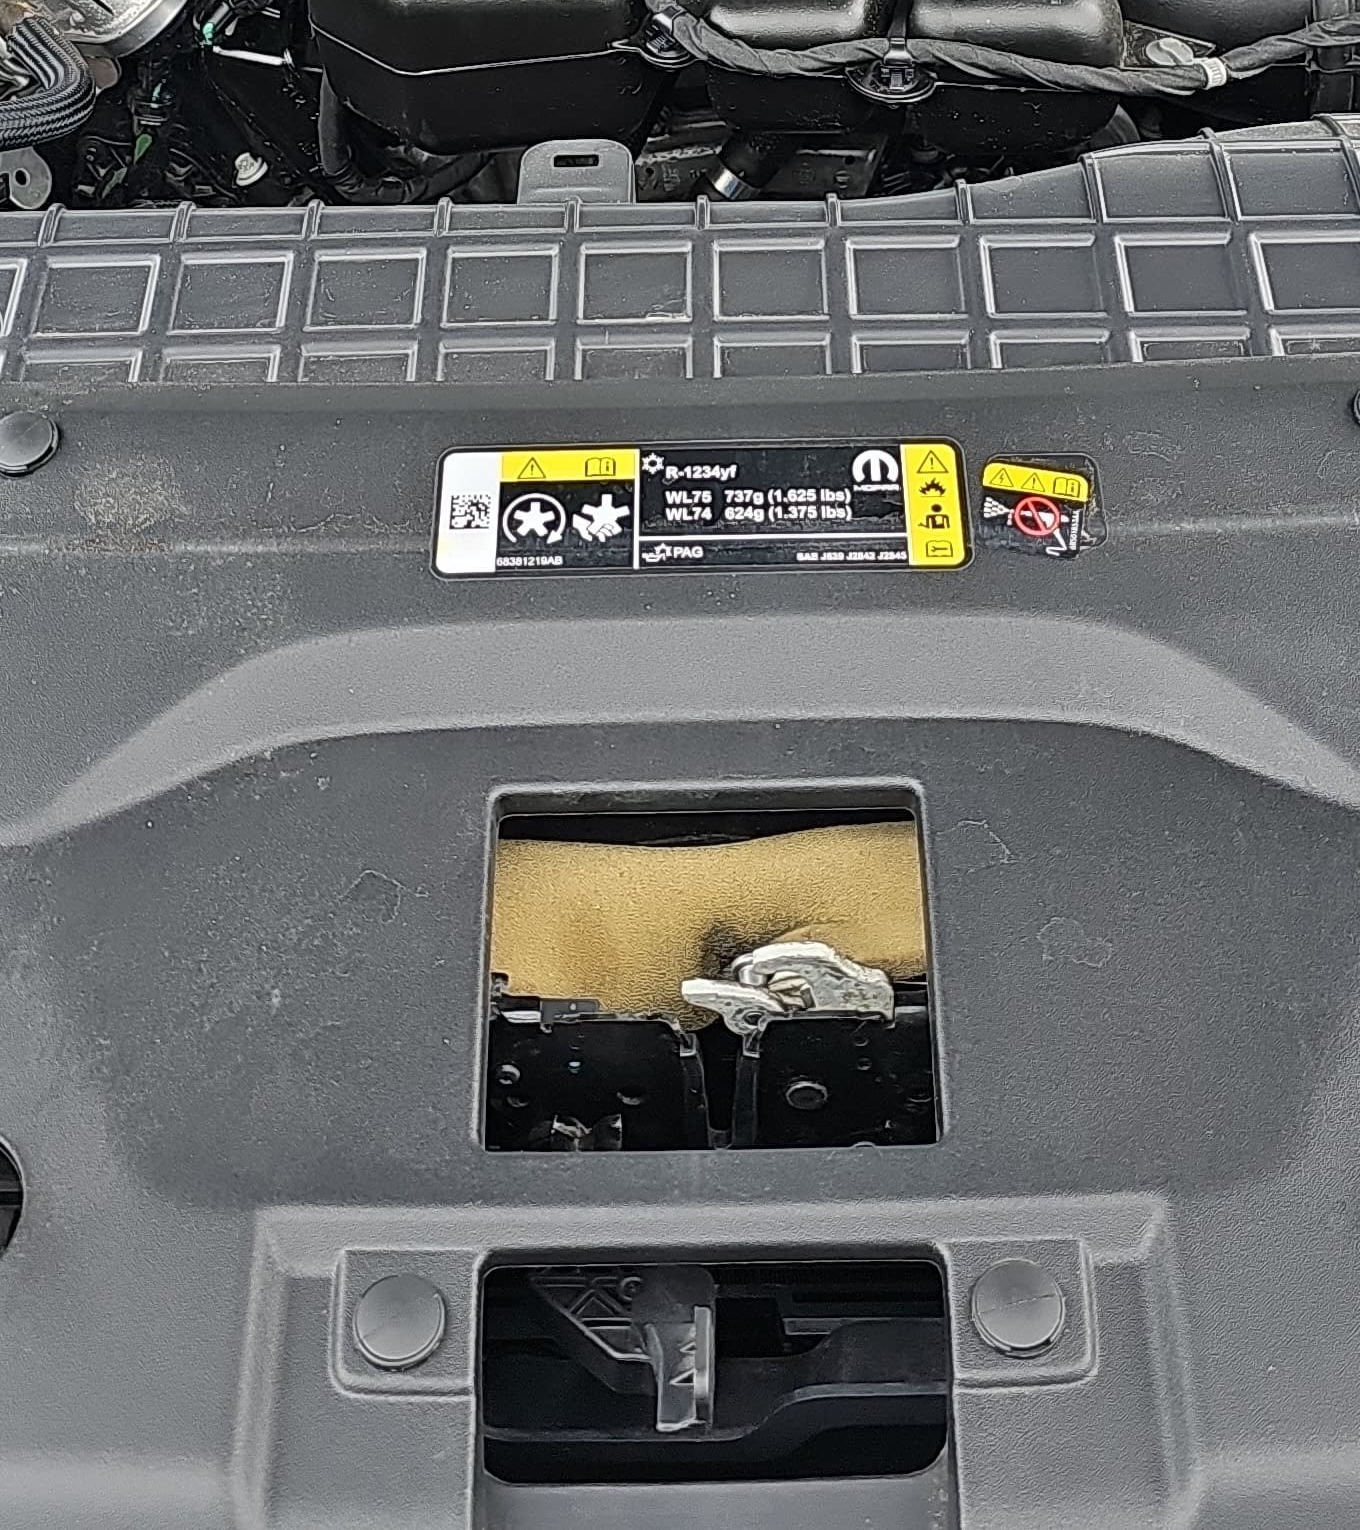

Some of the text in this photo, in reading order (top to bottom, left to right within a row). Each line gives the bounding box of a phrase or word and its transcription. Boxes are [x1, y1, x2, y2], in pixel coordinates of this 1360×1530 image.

[665, 464, 738, 482] R-1234yf
[665, 487, 852, 505] WL75 737g (1.625 lbs)
[665, 504, 853, 522] WL74 624g (1.375 lbs)
[673, 545, 704, 559] PAG
[796, 551, 819, 561] SAE
[820, 551, 845, 561] J639
[496, 555, 564, 567] 68381219AB
